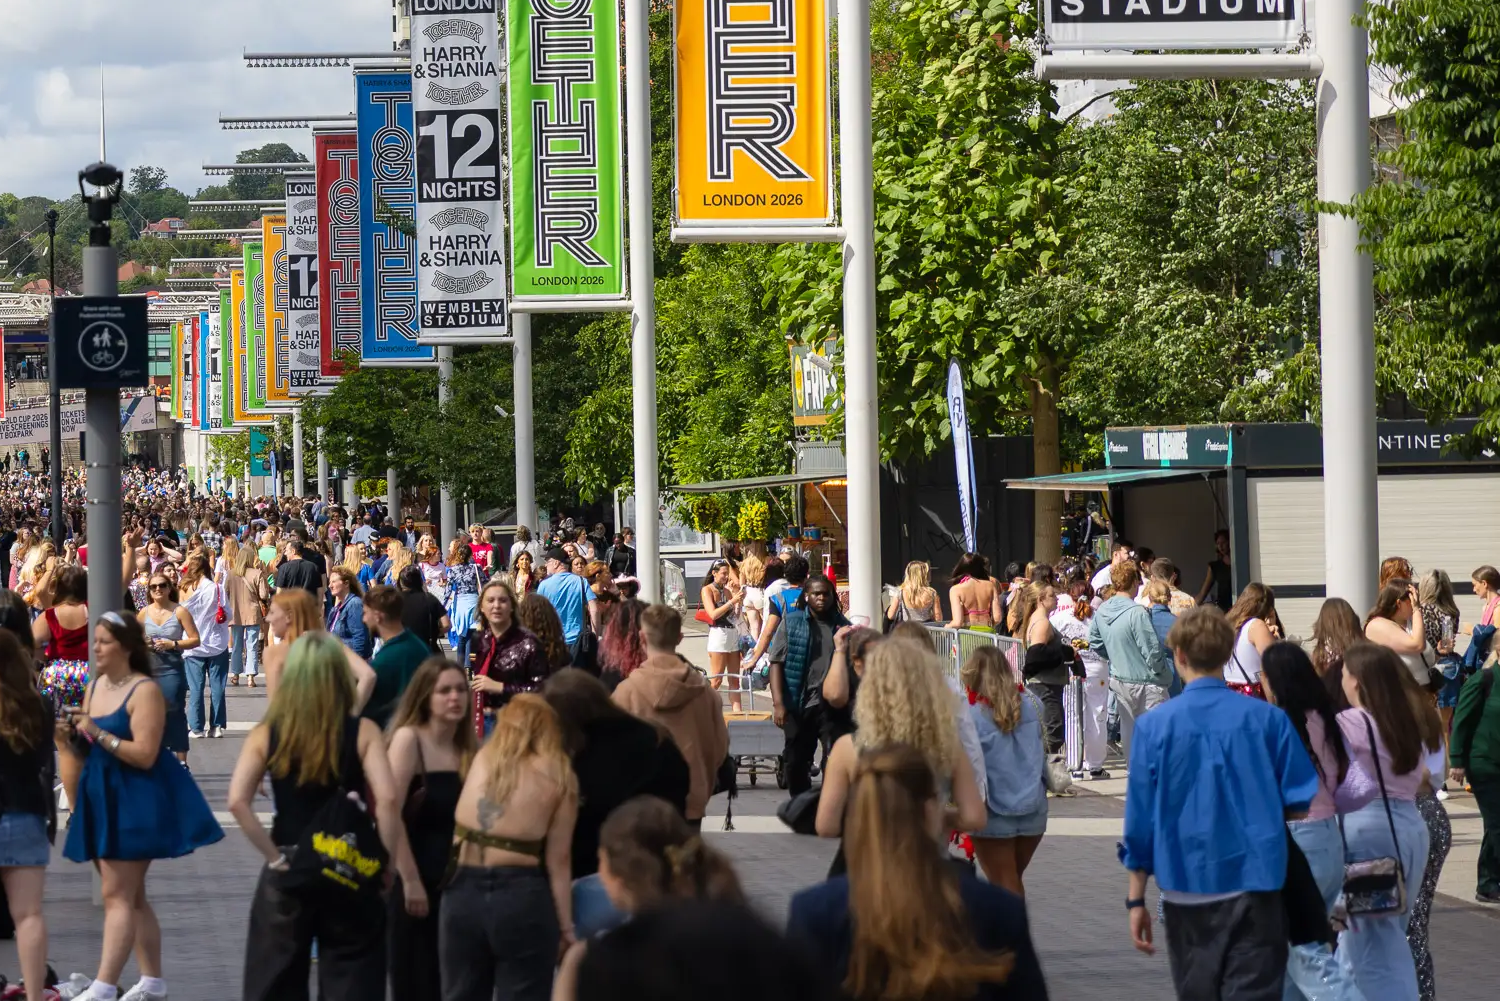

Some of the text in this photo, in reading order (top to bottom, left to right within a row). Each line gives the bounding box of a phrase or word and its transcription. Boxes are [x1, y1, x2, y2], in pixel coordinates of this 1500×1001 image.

[423, 19, 483, 44] TOGETHER
[424, 46, 487, 62] HARRY
[426, 81, 489, 105] TOGETHER
[420, 113, 496, 179] 12
[288, 184, 316, 194] LOND
[423, 181, 496, 198] NIGHTS
[703, 193, 803, 207] LONDON 2026
[294, 216, 316, 225] HAR
[429, 207, 489, 232] TOGETHER
[430, 234, 492, 250] HARRY
[431, 270, 494, 294] TOGETHER
[532, 276, 604, 286] LONDON 2026
[292, 298, 319, 308] NIGH
[424, 301, 501, 314] WEMBLEY
[424, 314, 501, 326] STADIUM
[296, 330, 319, 340] HAR
[19, 415, 31, 423] CUP
[32, 413, 48, 421] 2026
[61, 410, 85, 418] TICKETS
[11, 421, 48, 431] SCREENINGS
[62, 425, 75, 433] NOW
[5, 429, 33, 439] BOXPARK
